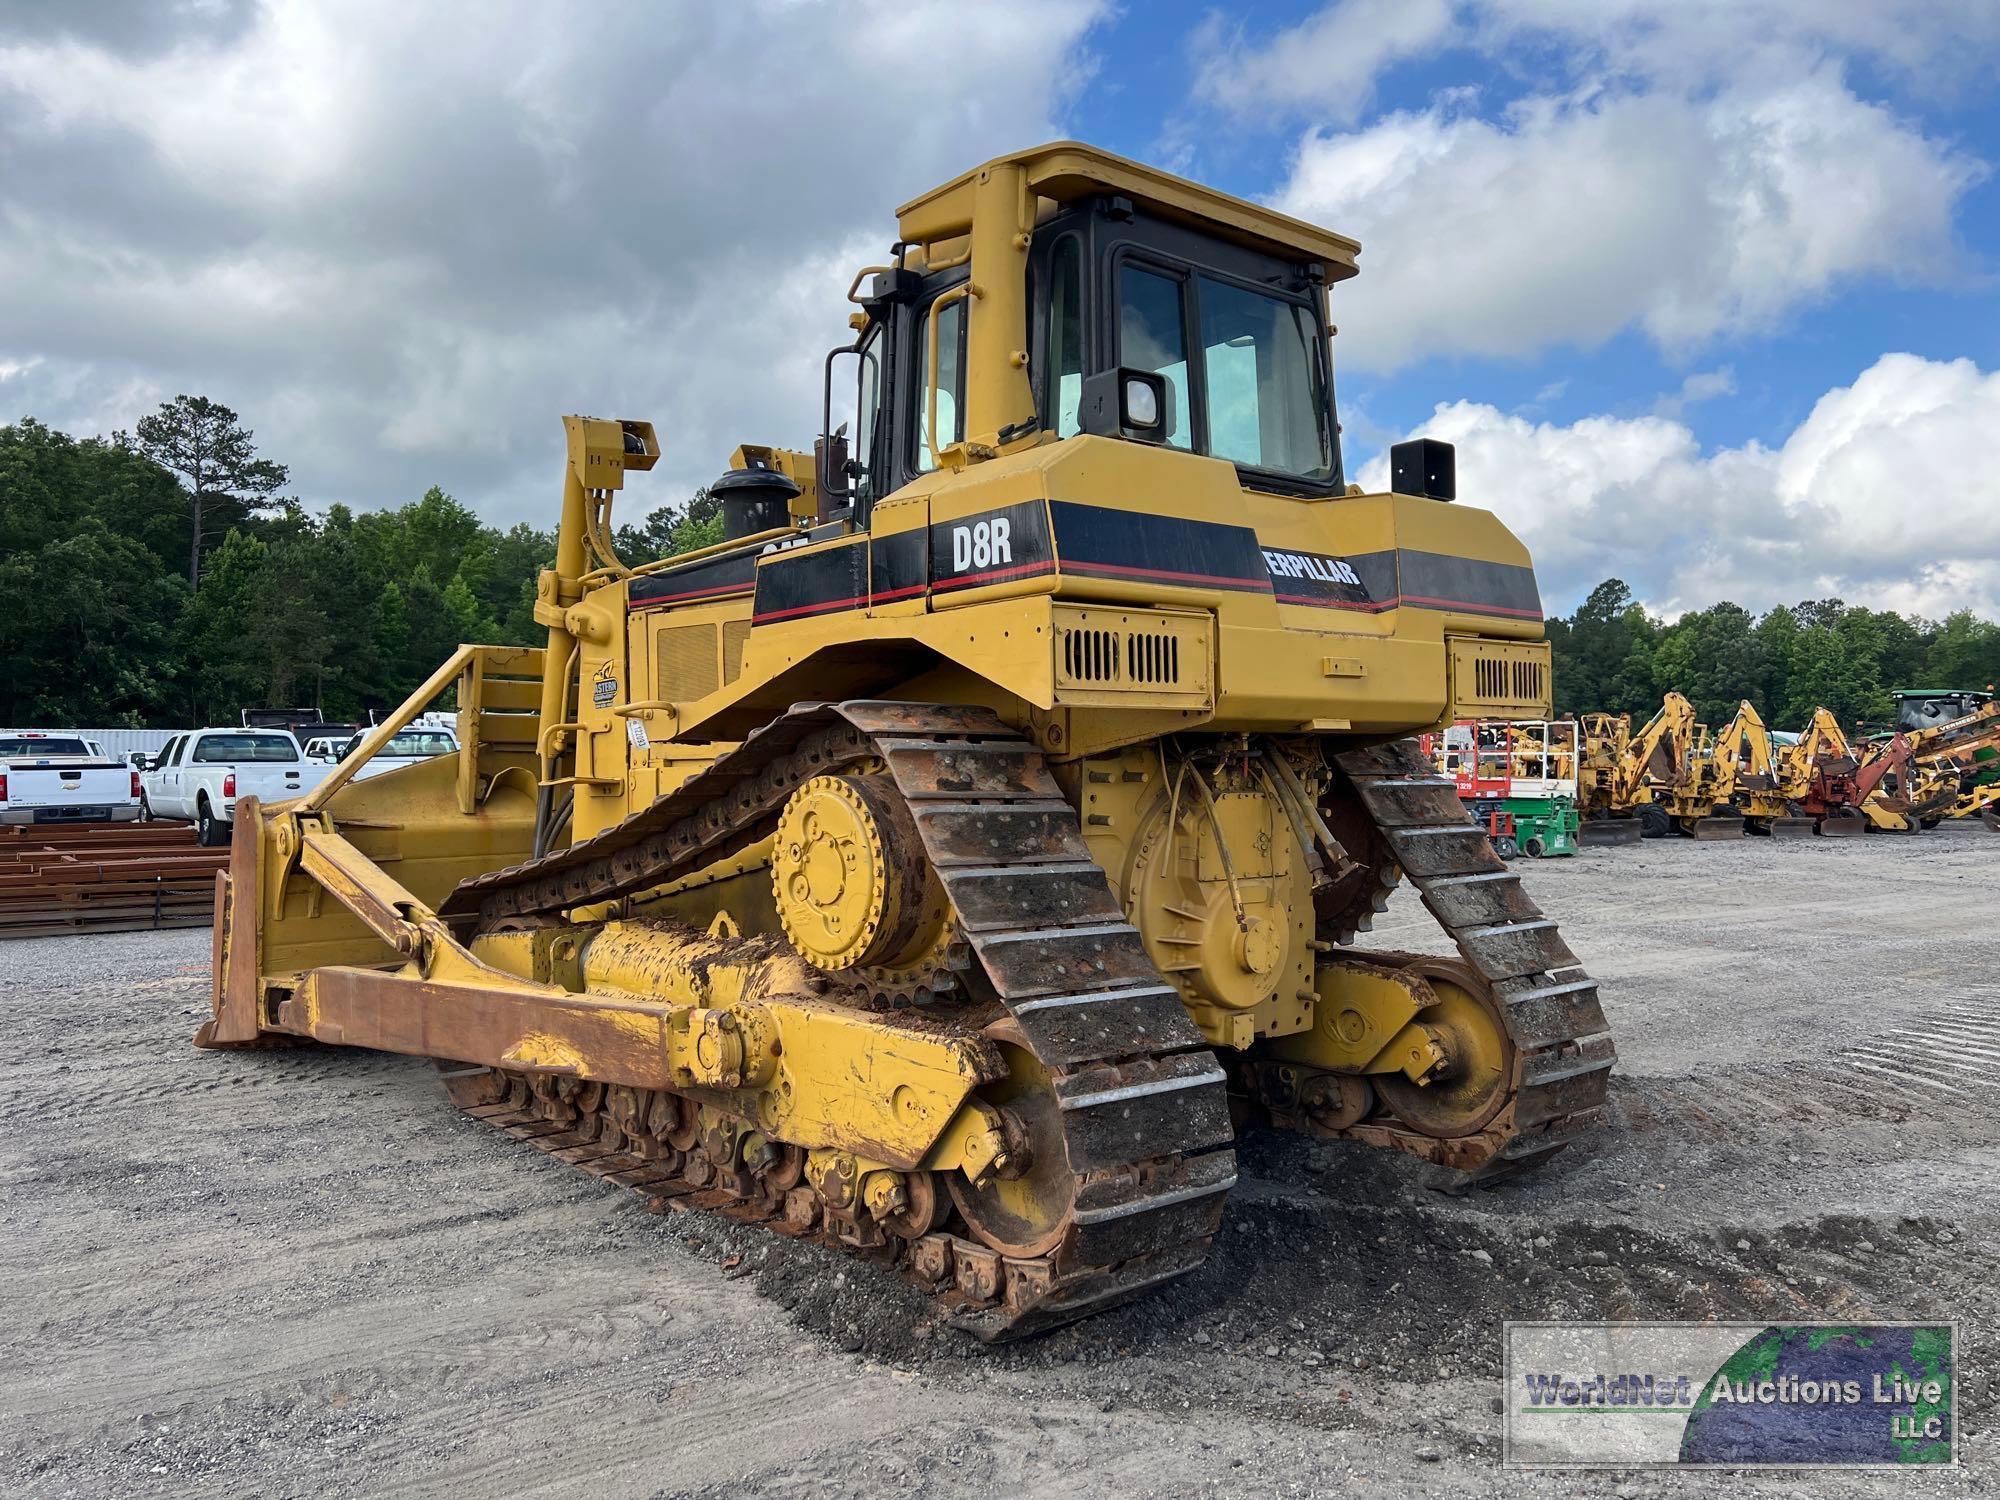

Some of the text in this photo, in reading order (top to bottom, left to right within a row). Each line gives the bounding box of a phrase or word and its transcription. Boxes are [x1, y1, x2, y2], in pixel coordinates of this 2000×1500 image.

[953, 517, 1013, 573] D8R
[1261, 550, 1361, 585] ERPILLAR
[1940, 715, 1977, 731] VERMEER
